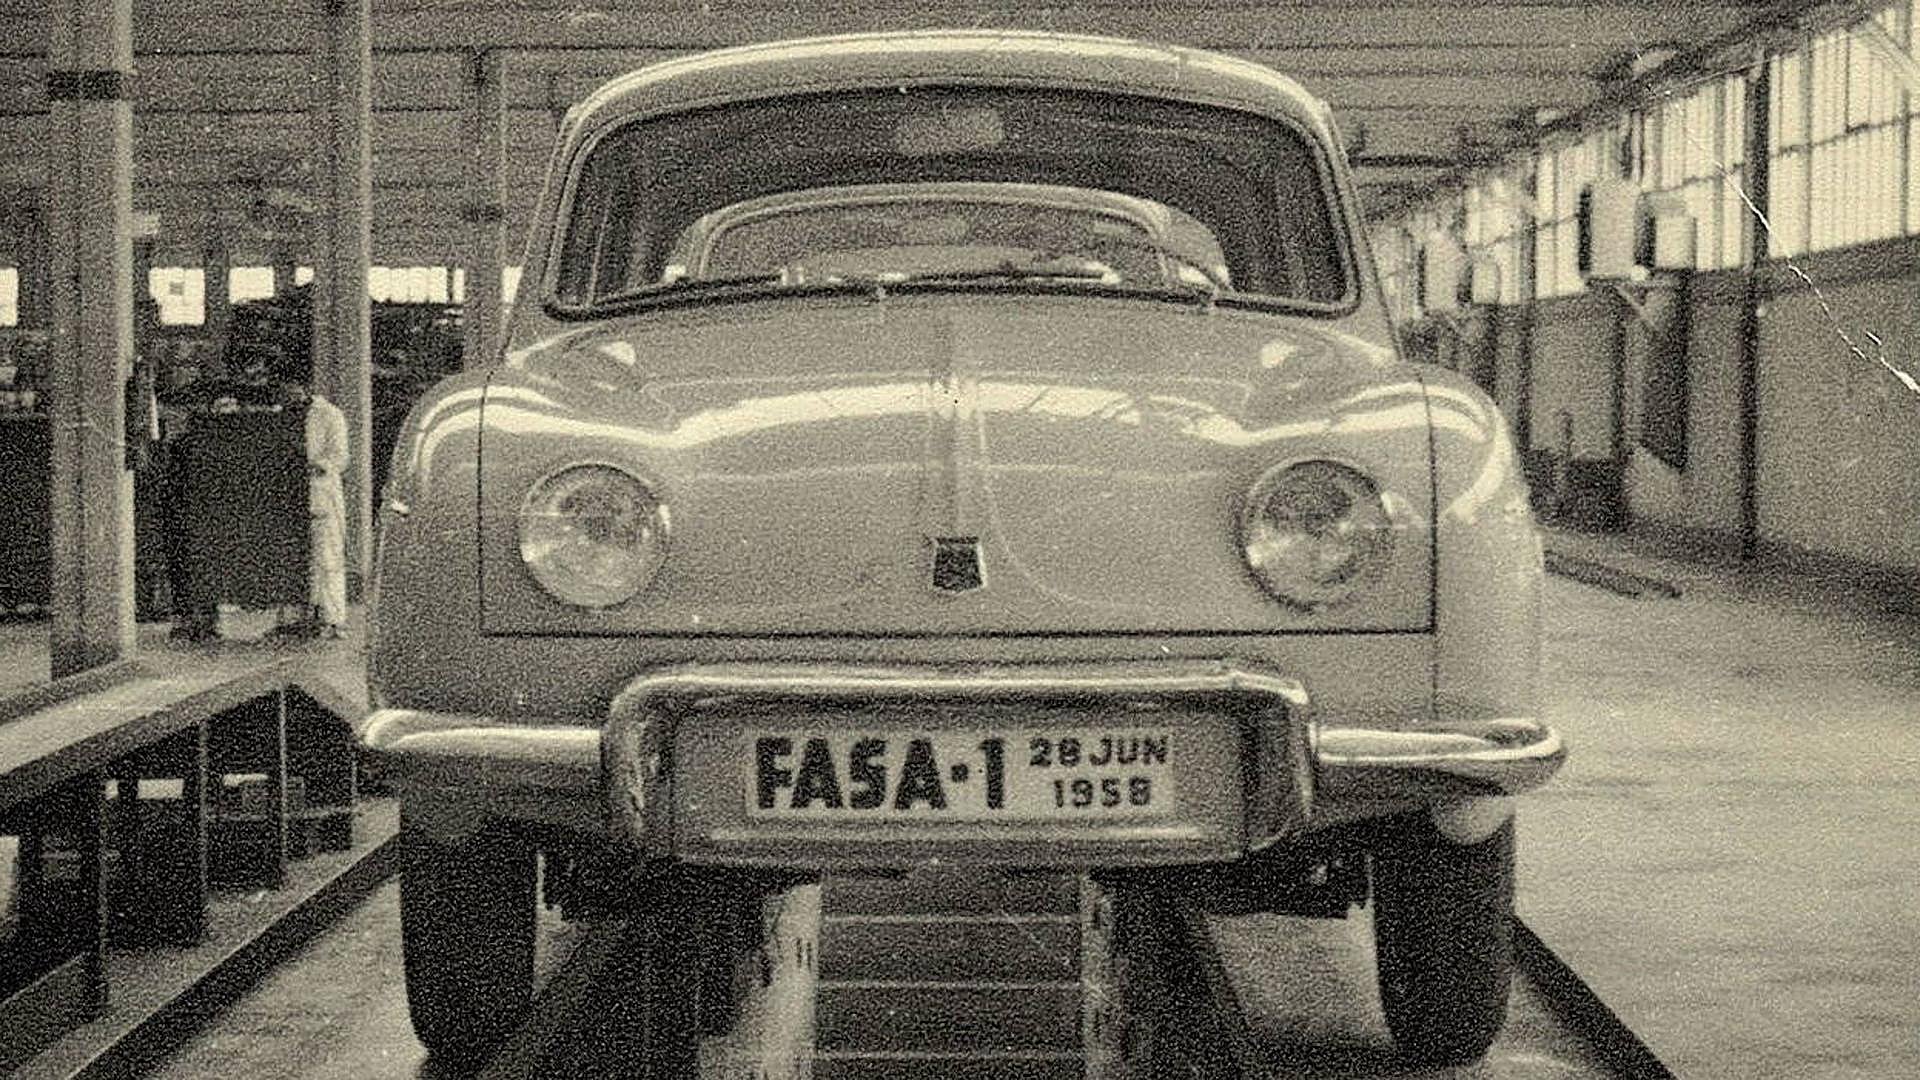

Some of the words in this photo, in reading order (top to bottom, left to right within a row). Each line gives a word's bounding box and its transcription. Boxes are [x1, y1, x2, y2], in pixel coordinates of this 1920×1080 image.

[1029, 737, 1081, 767] 28
[1088, 735, 1168, 766] JUN
[1053, 777, 1152, 808] 1958
